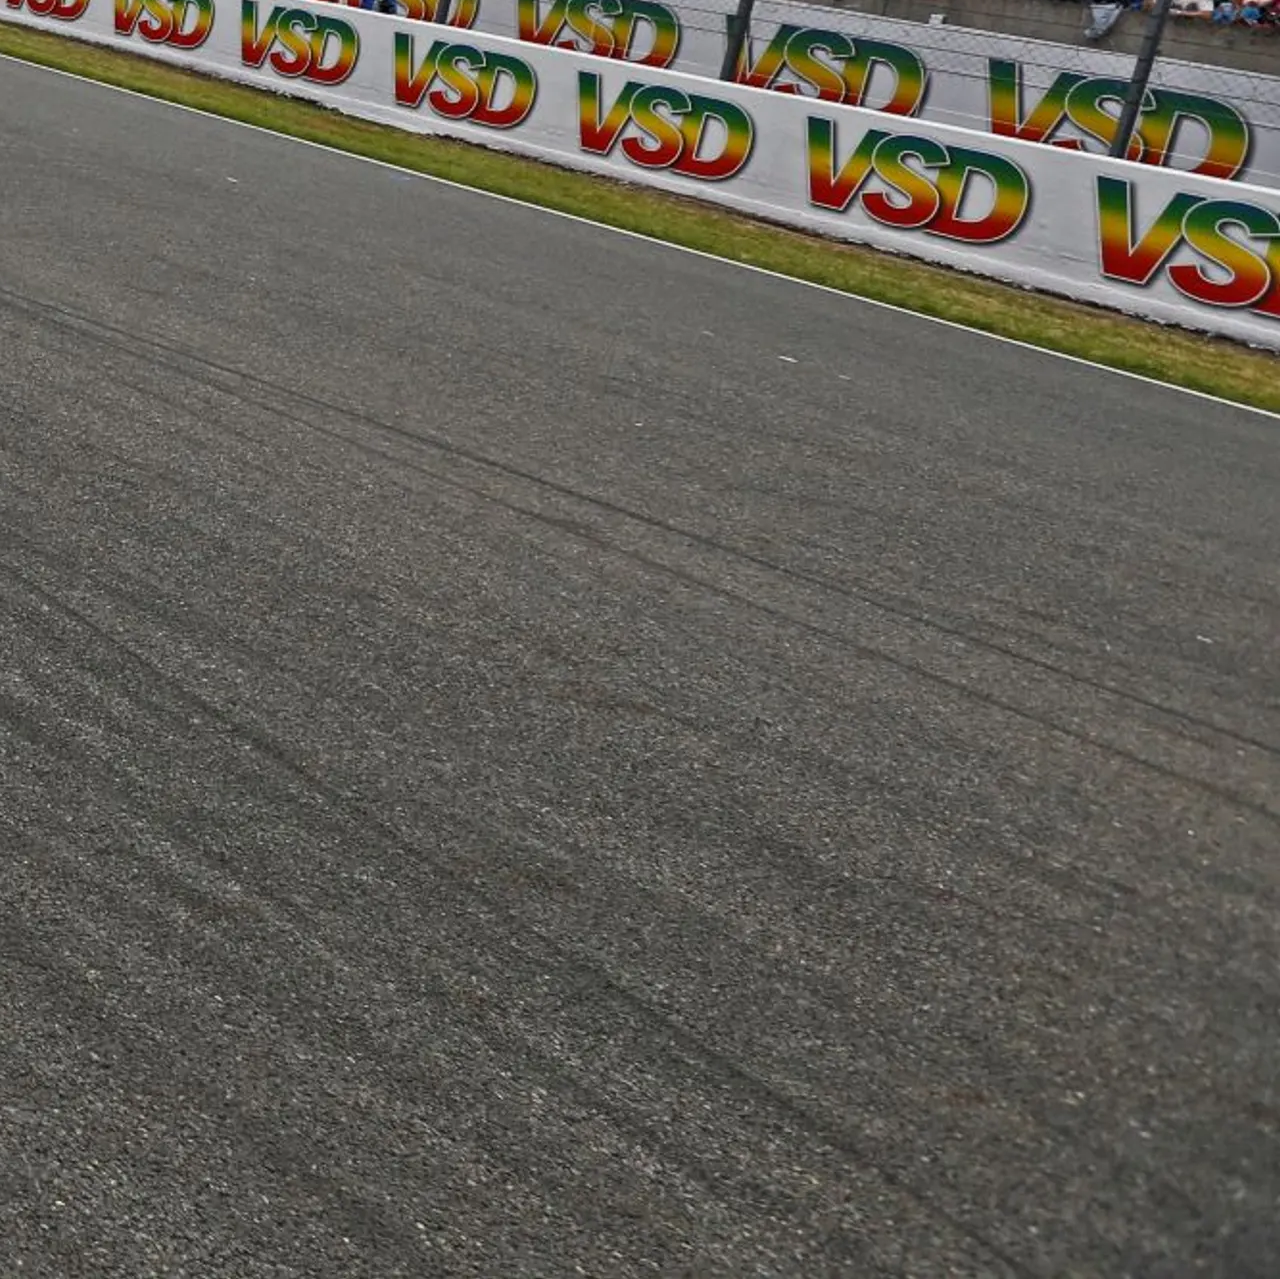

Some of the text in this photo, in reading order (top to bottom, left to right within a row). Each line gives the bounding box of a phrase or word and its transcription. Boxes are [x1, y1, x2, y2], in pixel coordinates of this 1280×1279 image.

[241, 0, 359, 85] VSD
[394, 32, 537, 128] VSD
[578, 70, 754, 181] VSD
[988, 58, 1249, 181] VSD
[806, 116, 1032, 243] VSD
[1096, 174, 1280, 318] VS
